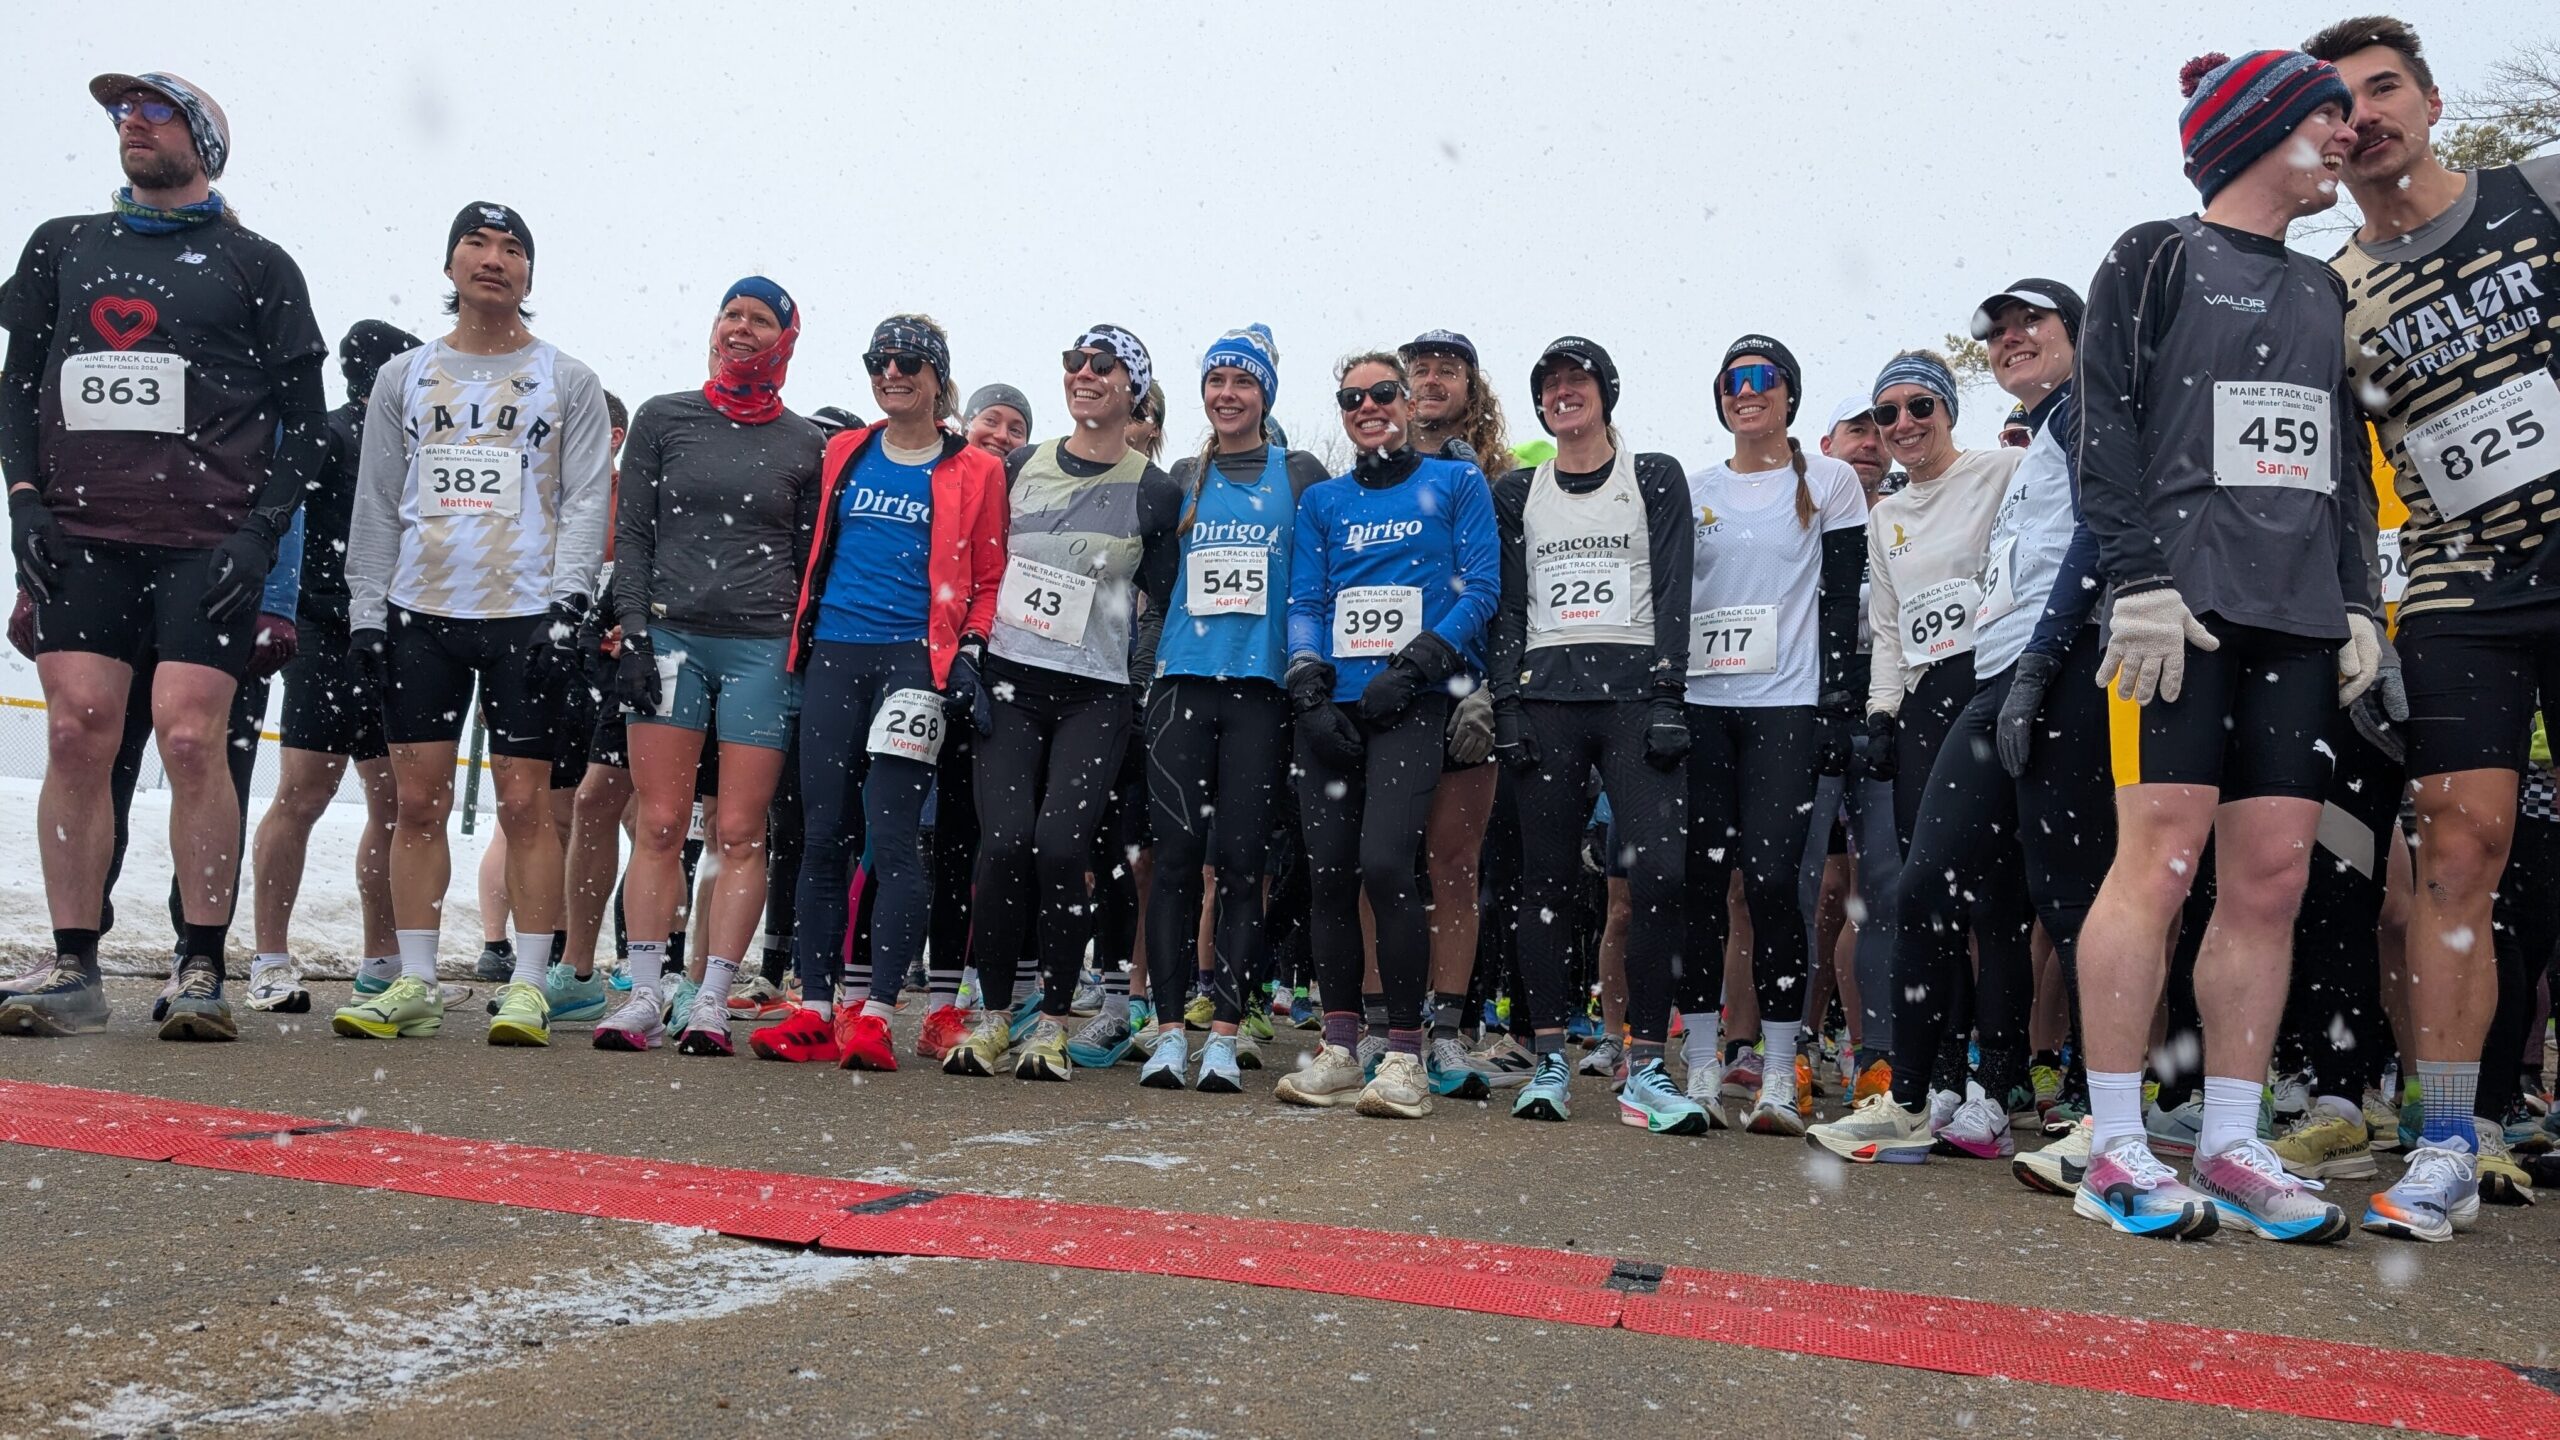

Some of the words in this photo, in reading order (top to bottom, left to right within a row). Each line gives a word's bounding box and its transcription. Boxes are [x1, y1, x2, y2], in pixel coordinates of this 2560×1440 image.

[80, 272, 175, 299] HARTBEAT
[2203, 294, 2266, 308] VALOR
[2378, 262, 2545, 359] VALOR
[2408, 331, 2482, 379] TRACK
[2484, 306, 2541, 343] CLUB
[108, 355, 140, 363] TRACK
[143, 357, 170, 365] CLUB
[1236, 358, 1271, 391] JOE'S
[81, 376, 161, 406] 863
[2229, 387, 2266, 397] MAINE
[2270, 387, 2302, 400] TRACK
[2303, 391, 2323, 404] CLUB
[2282, 400, 2301, 410] Classic
[2302, 403, 2316, 412] 2026
[2416, 417, 2452, 441] MAINE
[2452, 396, 2496, 421] TRACK
[2498, 379, 2533, 399] CLUB
[2471, 407, 2499, 424] Classic
[2501, 396, 2523, 410] 2026
[404, 403, 551, 448] VALOR
[2239, 416, 2319, 457] 459
[2440, 409, 2545, 481] 825
[432, 467, 501, 495] 382
[440, 498, 493, 508] Matthew
[850, 488, 930, 523] Dirigo
[1191, 519, 1266, 546] Dirigo
[1344, 519, 1423, 547] Dirigo
[1698, 523, 1723, 538] STC
[2379, 531, 2400, 540] RAC
[1536, 533, 1631, 559] seacoast
[1553, 551, 1584, 562] TRACK
[1587, 550, 1613, 559] CLUB
[1889, 542, 1912, 560] STC
[1016, 562, 1038, 573] MAINE
[1039, 567, 1063, 580] TRACK
[1544, 562, 1567, 574] MAINE
[1598, 561, 1620, 569] CLUB
[1203, 569, 1264, 595] 545
[1342, 590, 1361, 598] MAINE
[1550, 580, 1614, 608] 226
[1023, 587, 1062, 616] 43
[1215, 597, 1250, 607] Karley
[1902, 596, 1918, 611] MAINE
[1917, 586, 1942, 601] TRACK
[1943, 580, 1967, 592] CLUB
[1023, 614, 1051, 631] Maya
[1344, 609, 1404, 635] 399
[1561, 609, 1601, 620] Saeger
[1693, 612, 1715, 622] MAINE
[1717, 608, 1742, 617] TRACK
[1911, 603, 1966, 645] 699
[1350, 638, 1394, 649] Michelle
[1702, 628, 1752, 655] 717
[1929, 639, 1955, 655] Anna
[1708, 657, 1746, 668] Jordan
[891, 692, 910, 700] AINE
[886, 709, 939, 742] 268
[2322, 1150, 2337, 1161] ON
